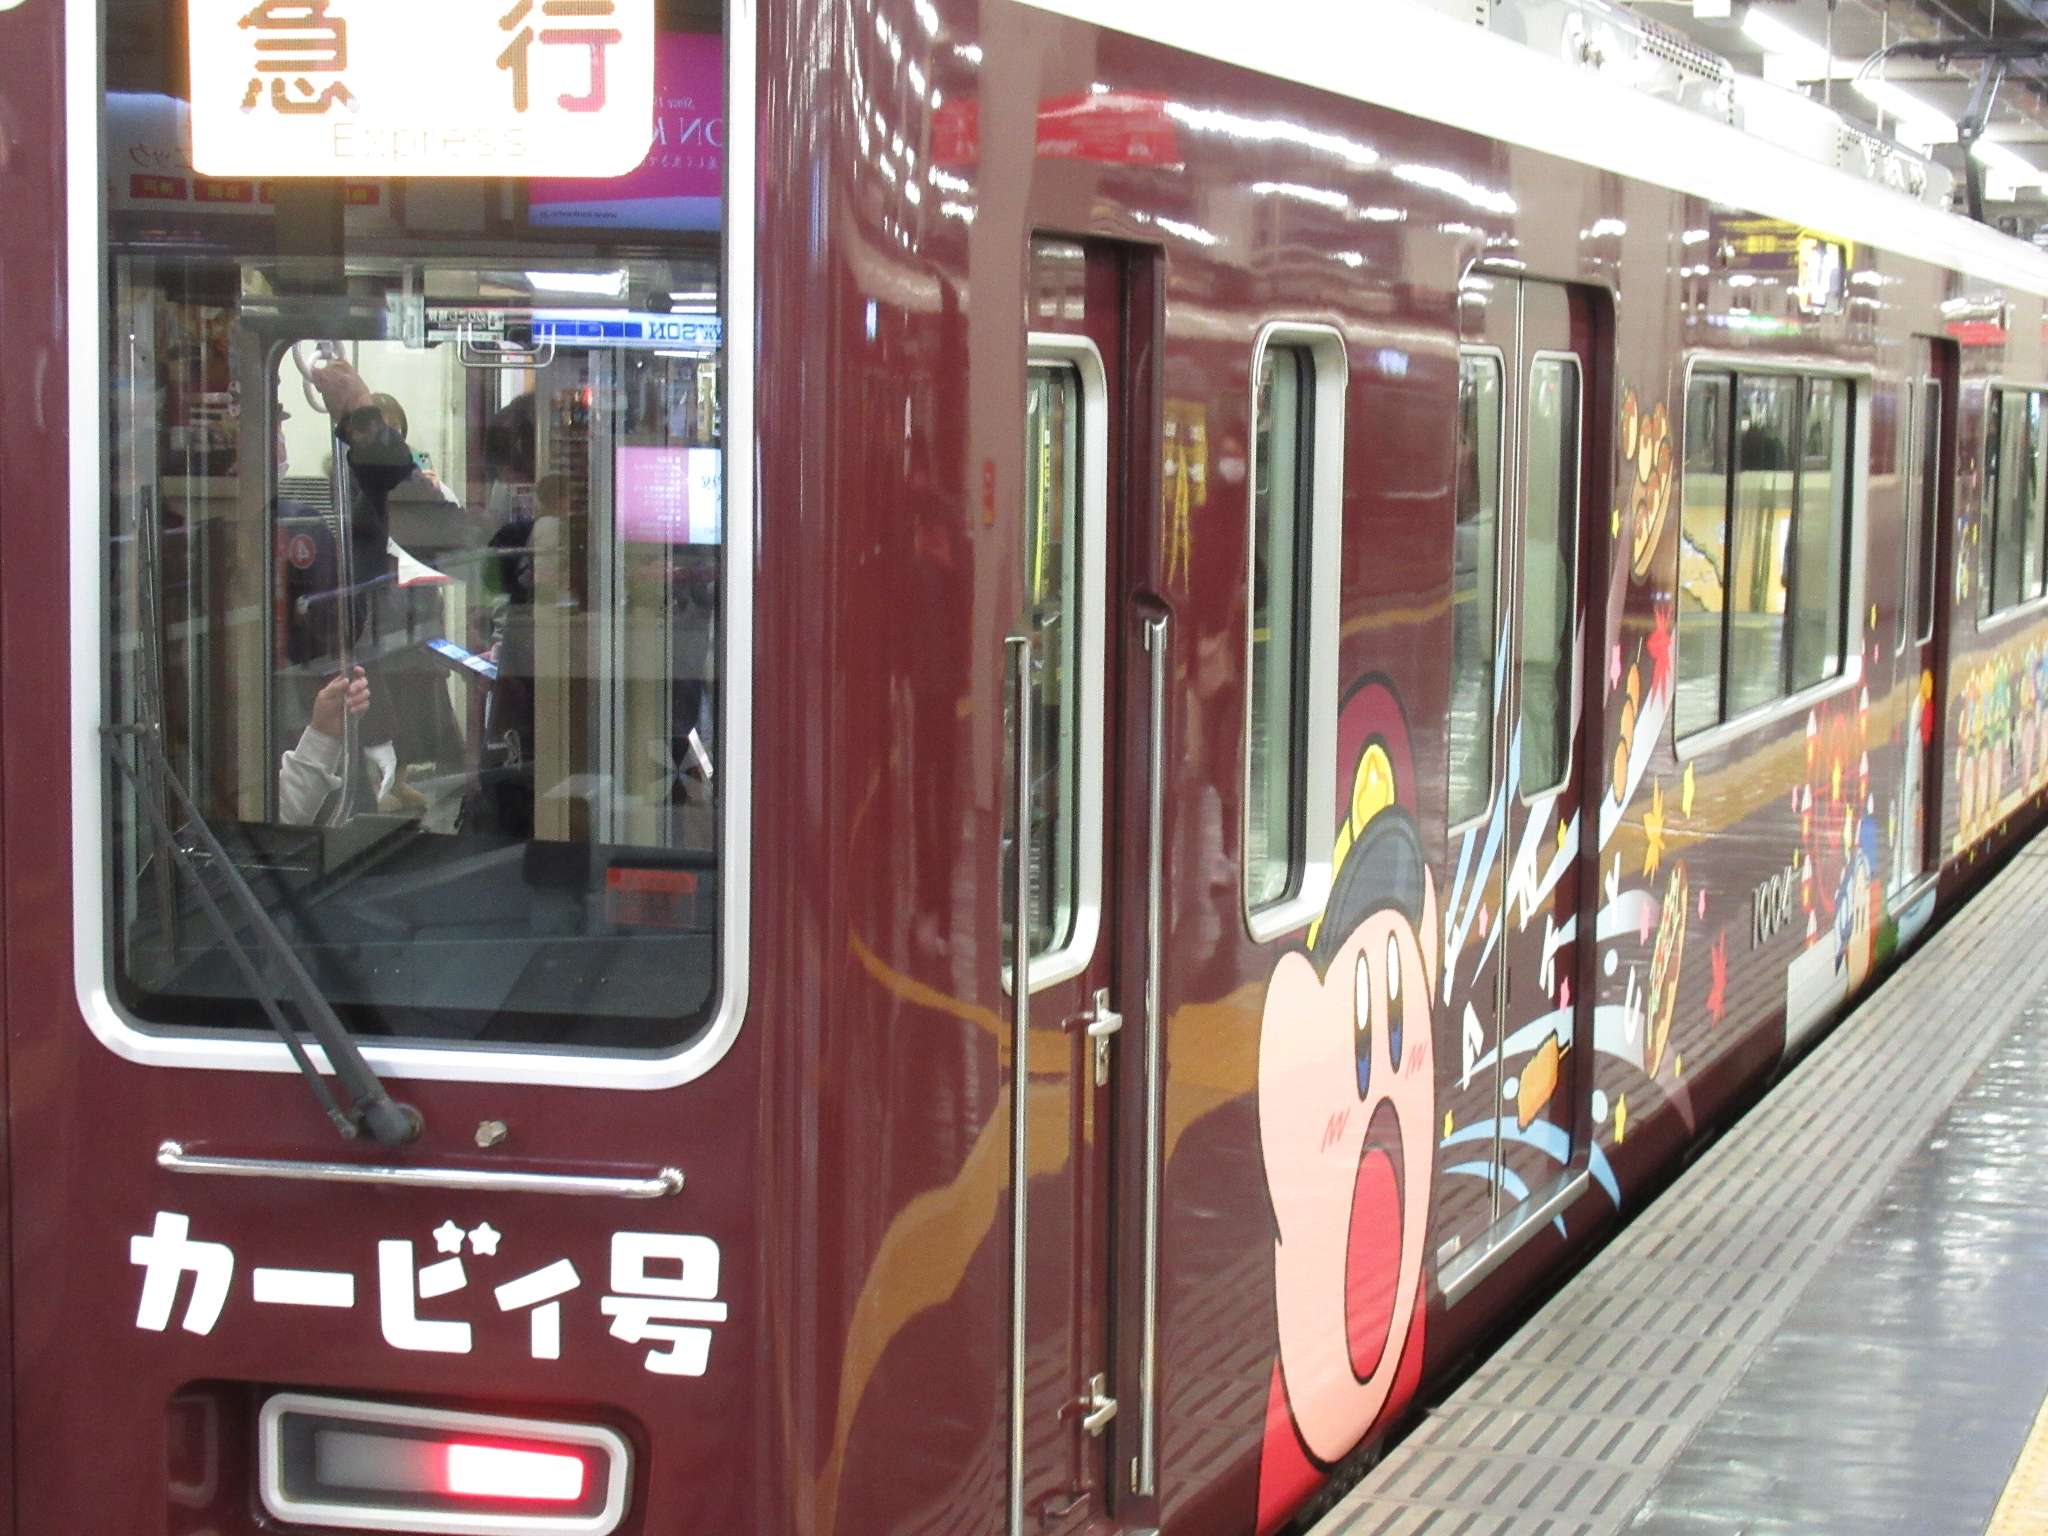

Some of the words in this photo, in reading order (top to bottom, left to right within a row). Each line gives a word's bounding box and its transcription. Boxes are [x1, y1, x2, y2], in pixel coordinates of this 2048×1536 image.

[1747, 865, 1792, 950] 1004
[129, 1210, 728, 1377] カービィ号
